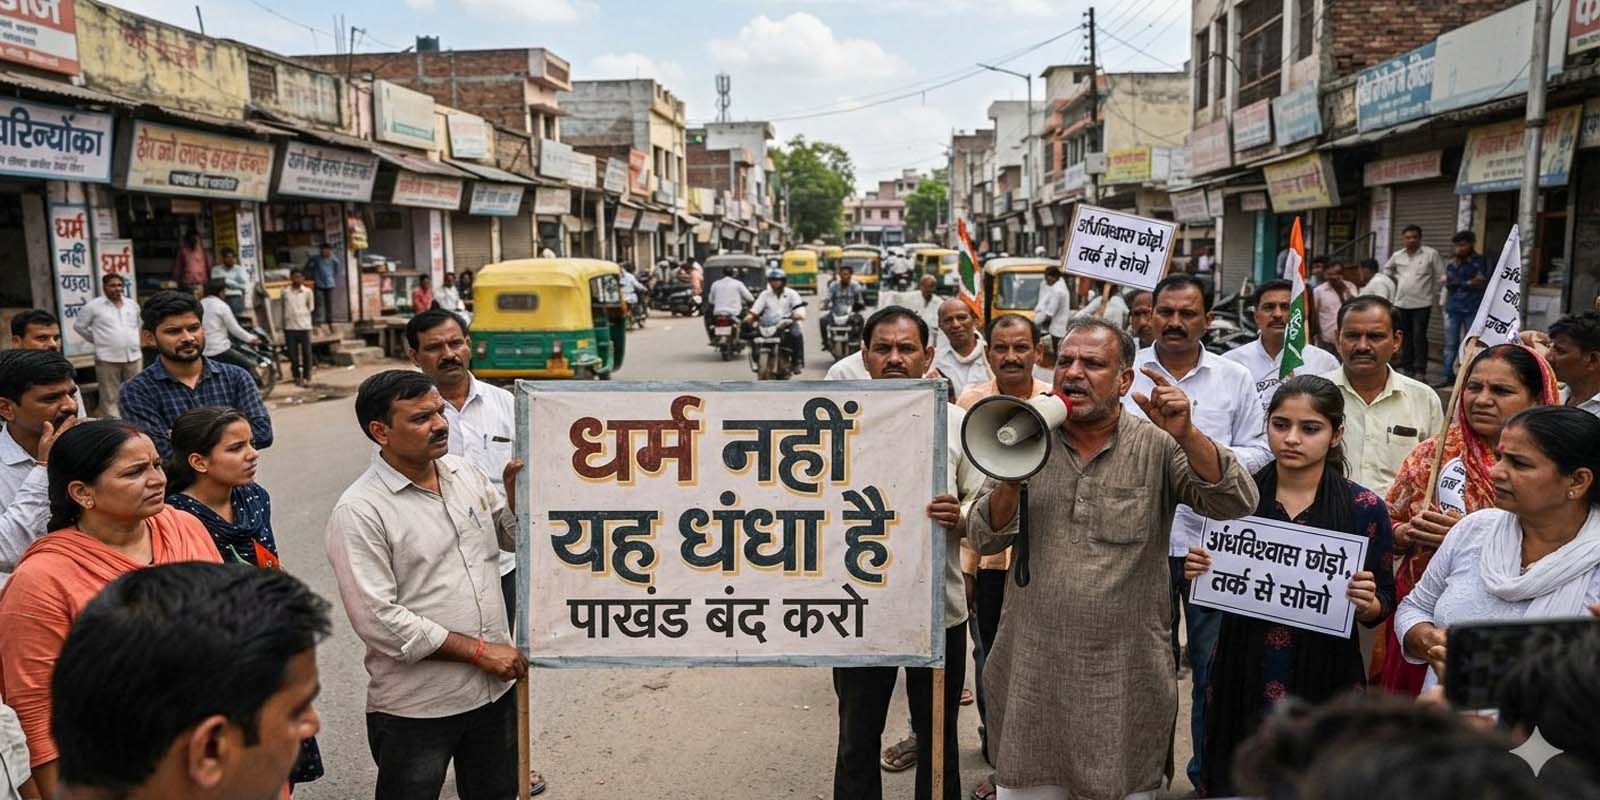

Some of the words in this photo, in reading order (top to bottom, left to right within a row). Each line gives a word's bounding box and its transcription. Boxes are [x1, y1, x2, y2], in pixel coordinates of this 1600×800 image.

[55, 212, 83, 240] धर्म
[101, 246, 130, 273] धर्म
[569, 395, 703, 485] धर्म
[722, 397, 861, 495] नहीं
[549, 510, 663, 585] यह
[678, 490, 828, 575] धंधा
[842, 485, 899, 587] है
[1206, 525, 1302, 567] अंधविश्वास
[1305, 544, 1352, 581] छोड़ो,
[567, 586, 692, 638] पाखंड
[705, 586, 770, 643] बंद
[783, 583, 869, 638] करो
[1212, 568, 1251, 595] तर्क
[1254, 573, 1275, 603] से
[1280, 580, 1332, 615] सोचो
